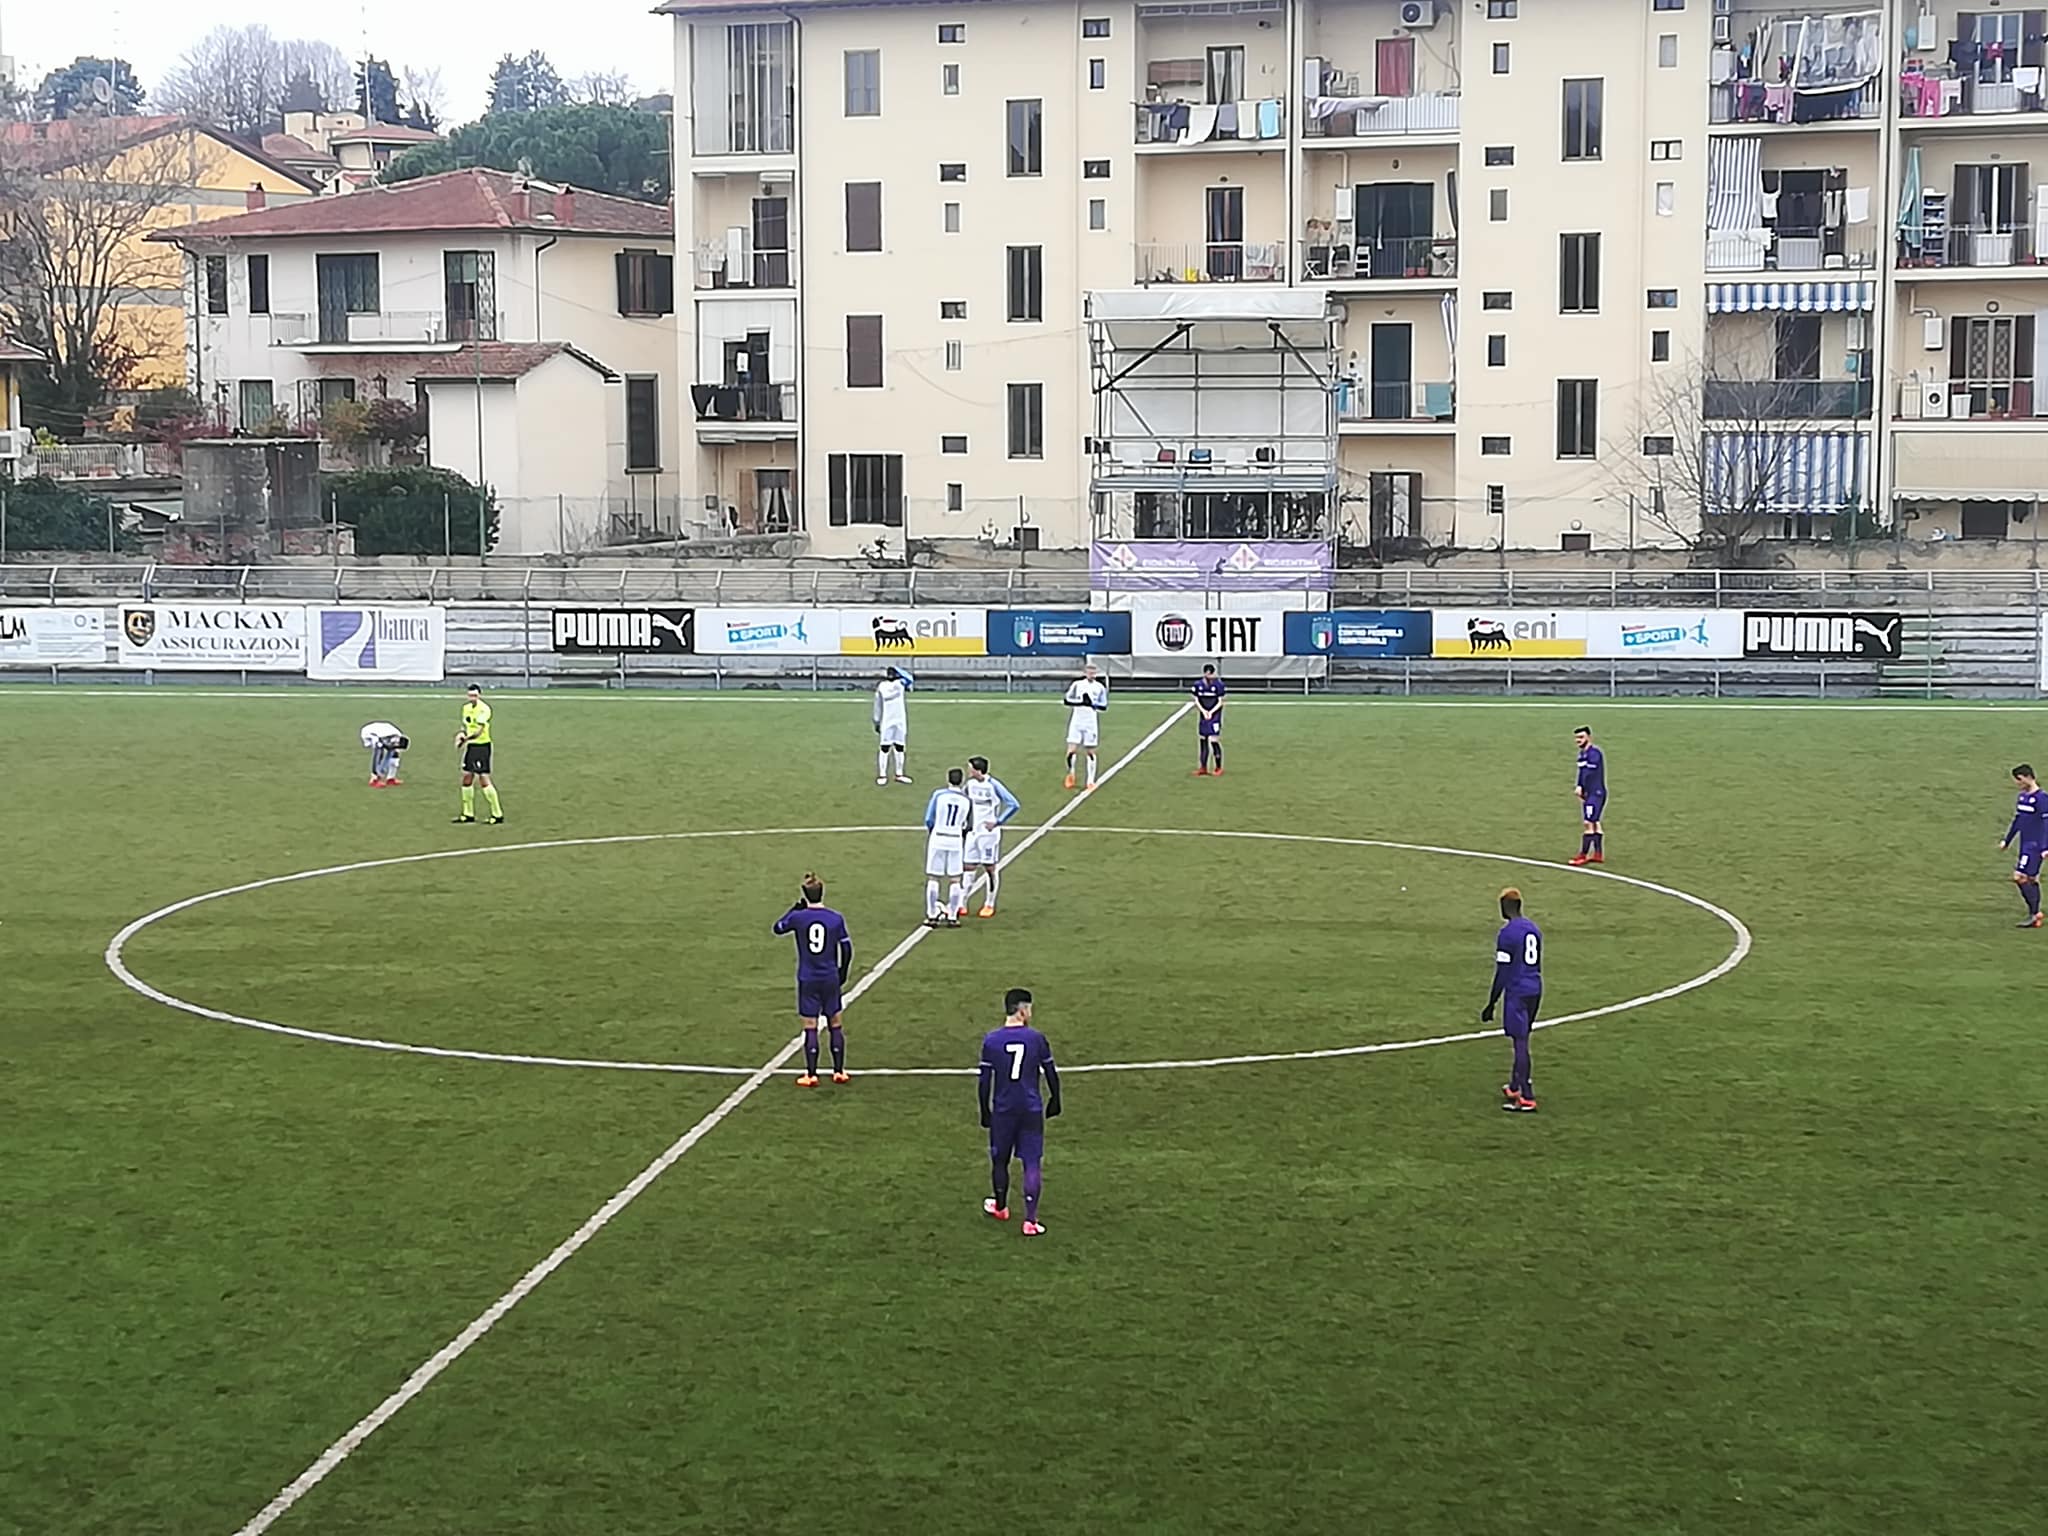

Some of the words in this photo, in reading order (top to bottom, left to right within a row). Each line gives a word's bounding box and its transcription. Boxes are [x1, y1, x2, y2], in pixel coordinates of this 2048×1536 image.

[168, 610, 289, 630] MACKAY
[916, 611, 957, 638] eni
[1513, 613, 1557, 639] eni
[159, 636, 300, 650] ASSICURAZIONI
[1206, 617, 1262, 652] FIAT
[947, 803, 960, 827] 11
[809, 922, 825, 954] 9
[1524, 933, 1538, 965] 8
[1005, 1043, 1025, 1080] 7
